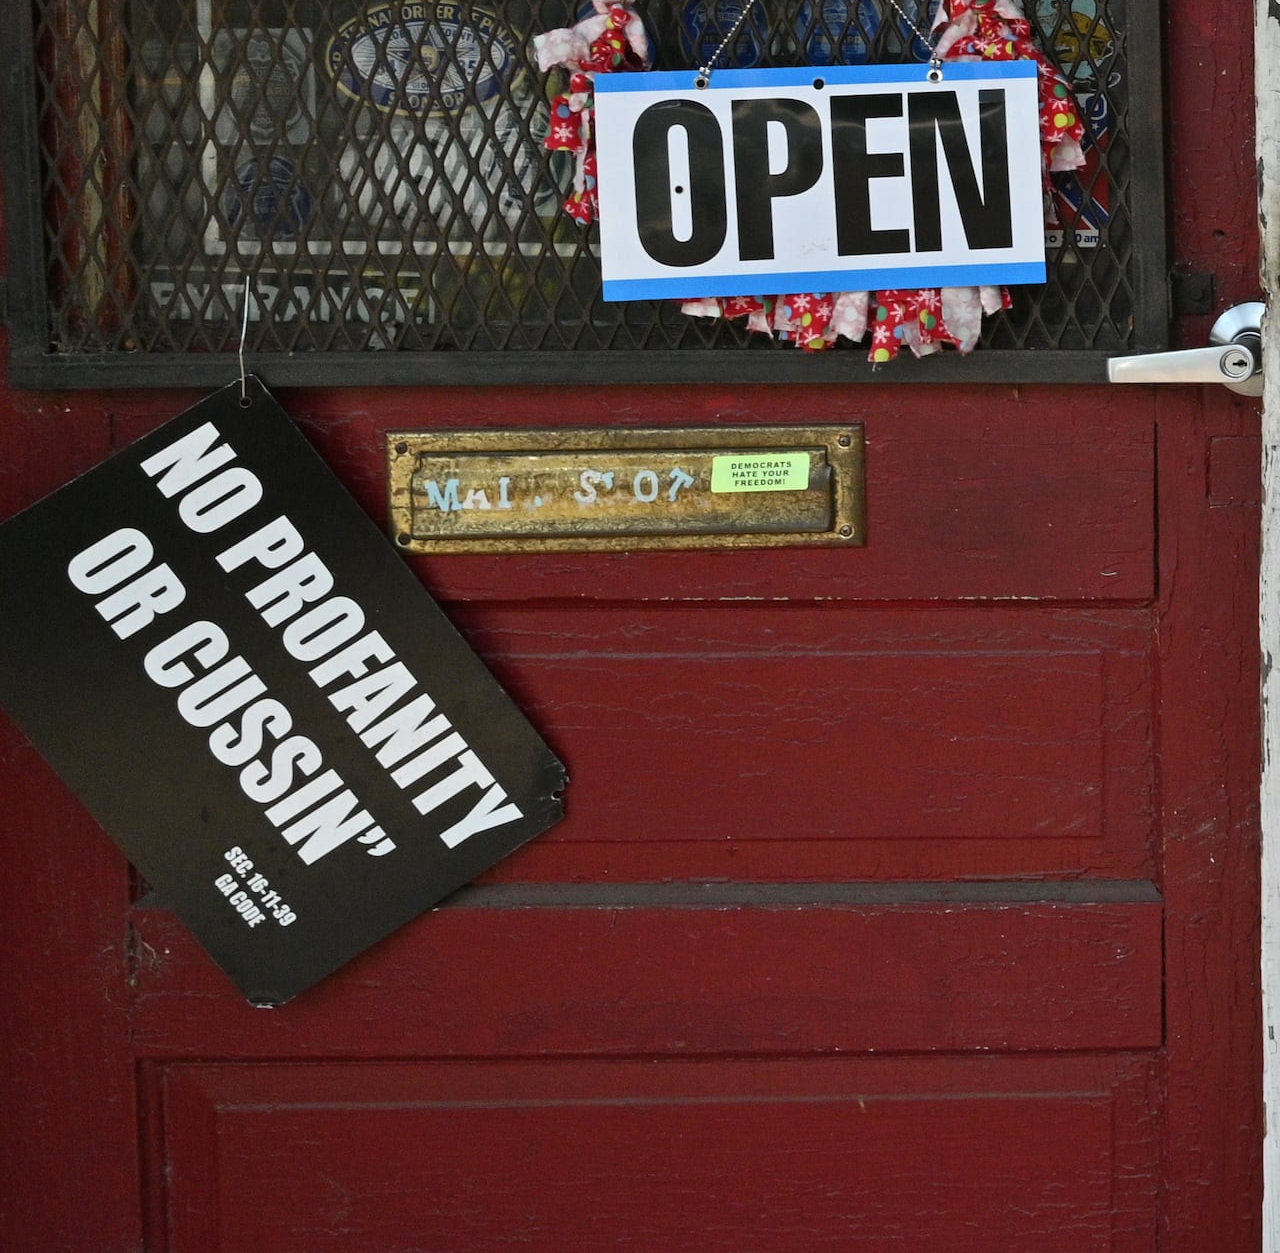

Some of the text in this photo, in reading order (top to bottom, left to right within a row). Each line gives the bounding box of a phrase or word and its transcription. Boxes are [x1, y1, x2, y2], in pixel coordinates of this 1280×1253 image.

[631, 88, 1014, 267] OPEN
[425, 468, 696, 513] MAI SOT
[731, 461, 792, 470] DEMOCRATS
[734, 478, 786, 486] FREEDOM!
[762, 469, 789, 477] YOUR
[67, 526, 187, 641] OR
[140, 421, 524, 849] NO PROFANITY
[215, 873, 266, 928] GA CODE
[224, 846, 297, 927] SEC. 16-11-39
